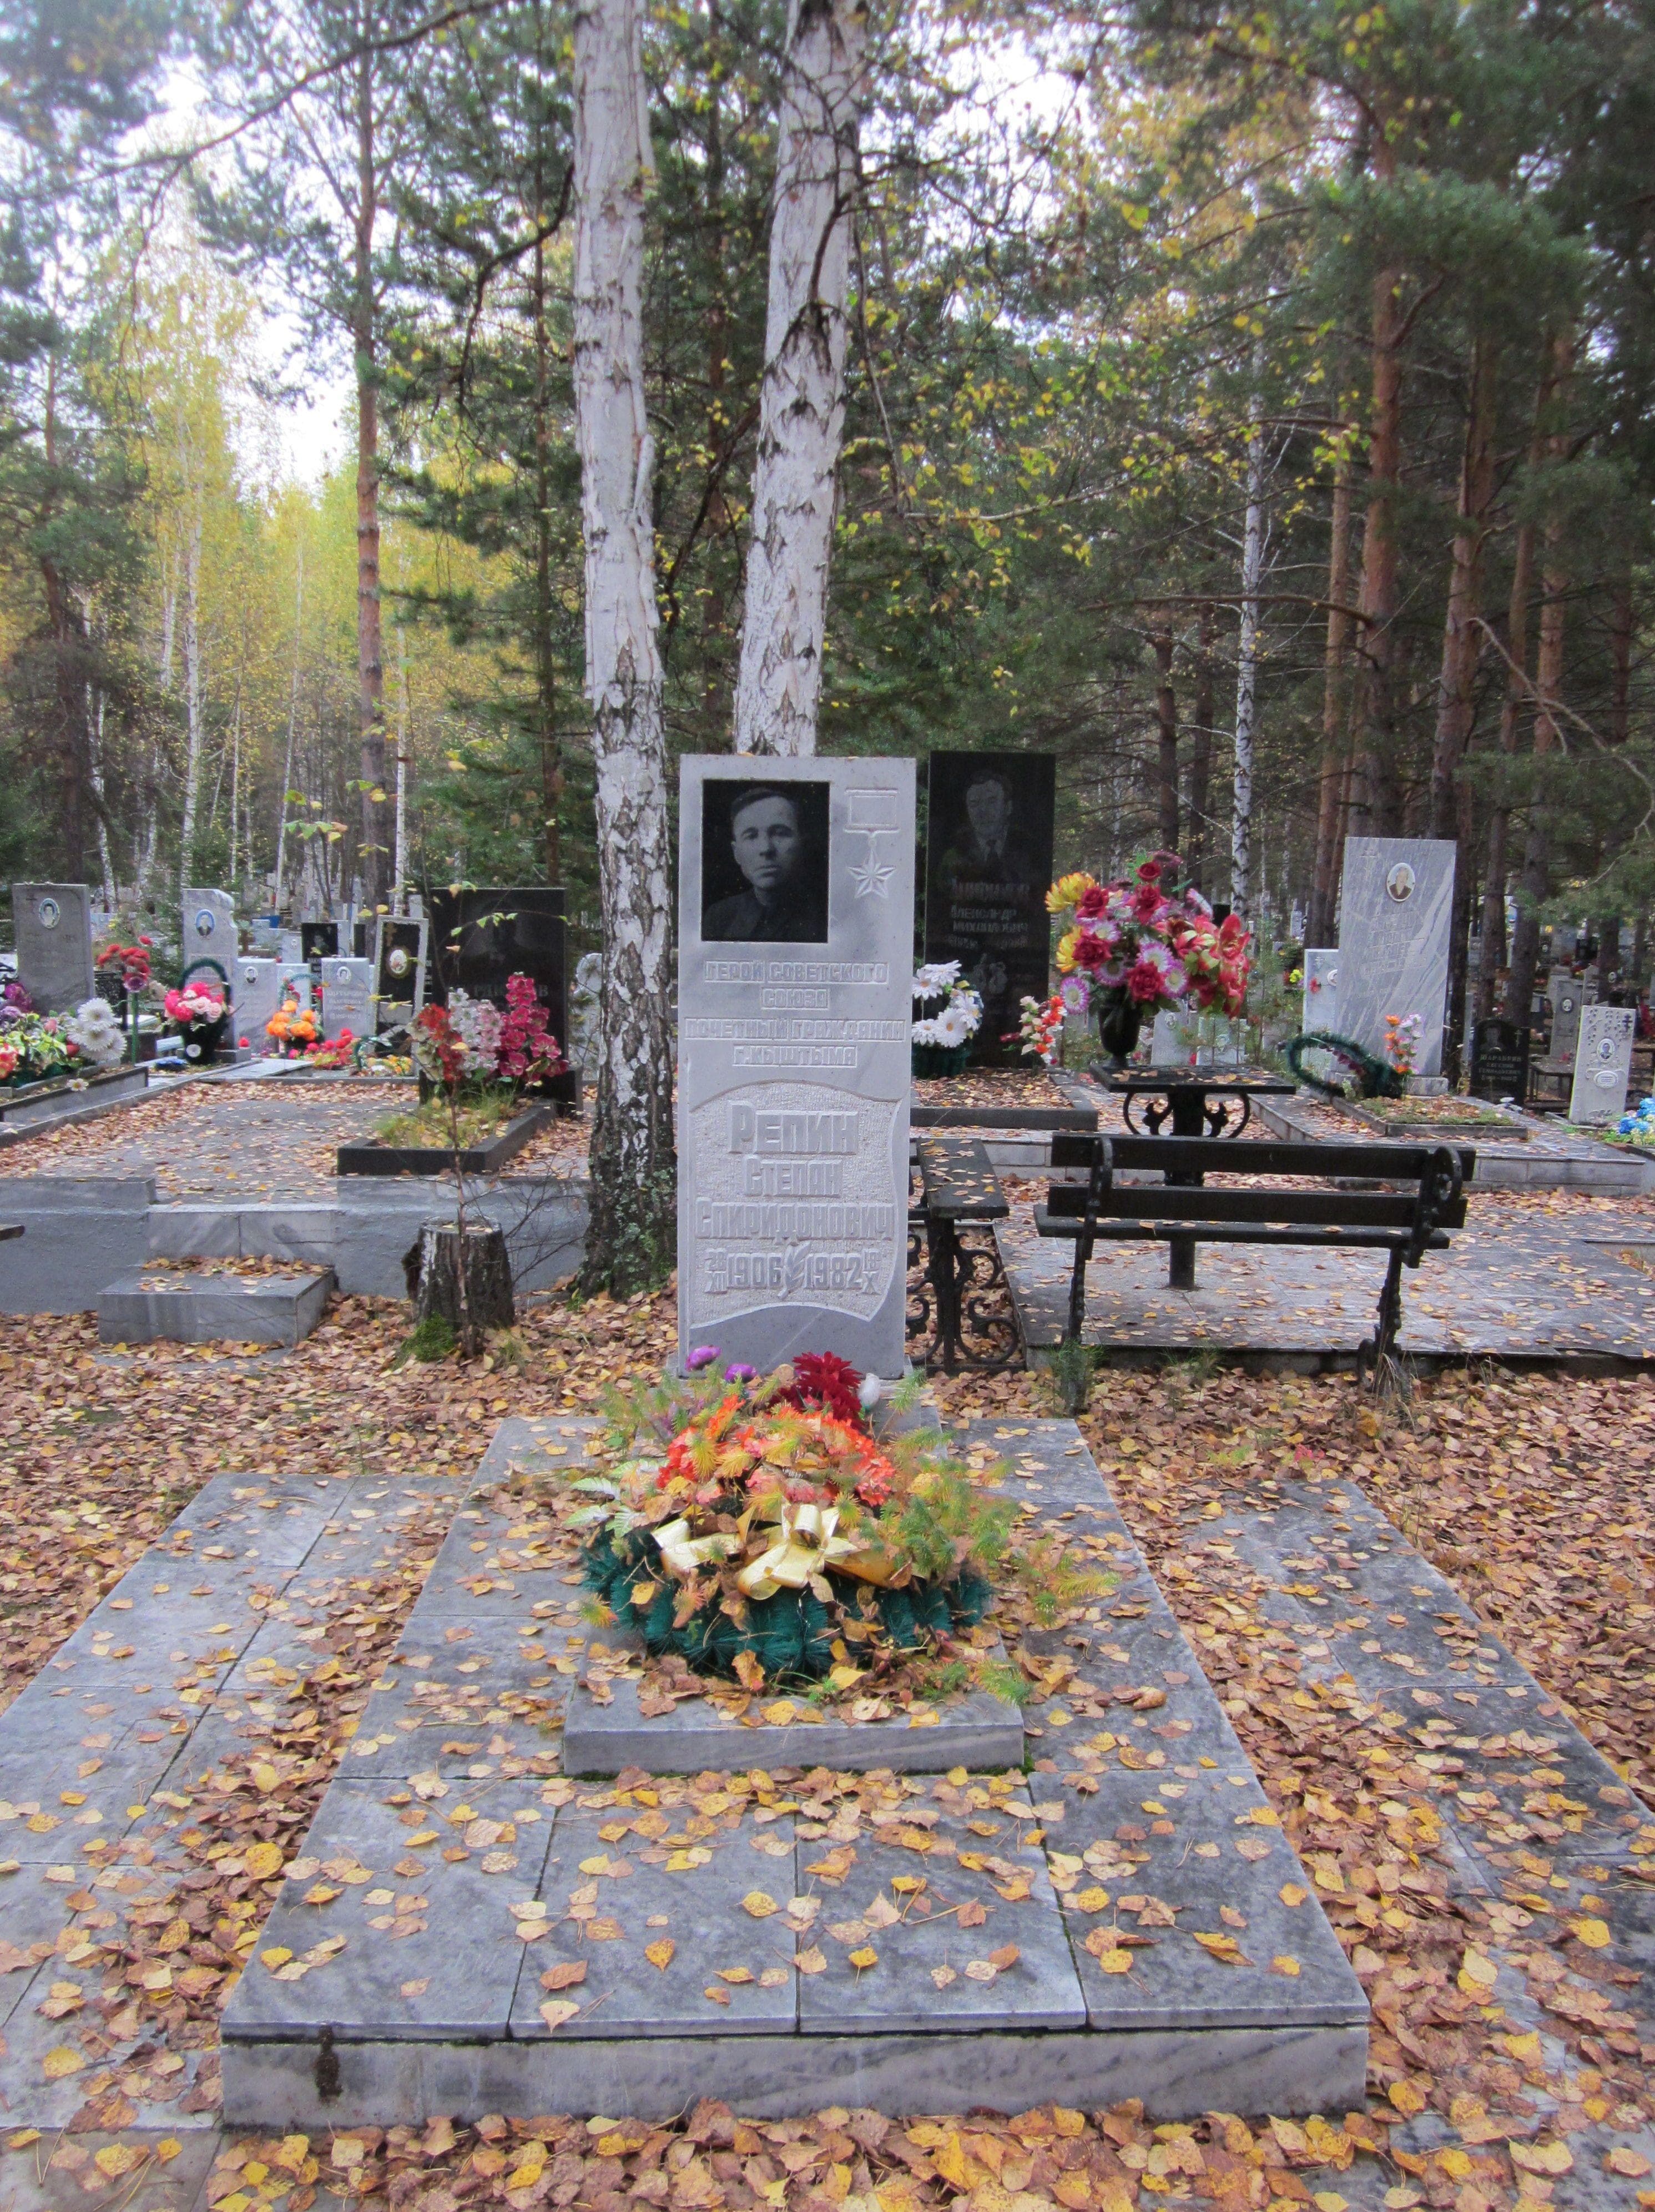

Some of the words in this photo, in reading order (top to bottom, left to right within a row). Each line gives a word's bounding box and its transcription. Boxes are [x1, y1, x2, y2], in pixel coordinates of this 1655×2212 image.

[705, 961, 765, 982] ГЕРОЙ
[768, 962, 888, 984] СОВЕТСКОГО
[761, 988, 830, 1009] СОЮЗА
[685, 1018, 788, 1040] ПОЧЕТНЫЙ
[791, 1019, 905, 1042] ГРАЖДАНИН
[728, 1100, 859, 1155] РЕПИН
[743, 1155, 842, 1198] СТЕПАН
[695, 1197, 895, 1243] СПИРИДОНОВИЧ
[726, 1253, 783, 1289] 1906
[804, 1253, 862, 1291] 1982
